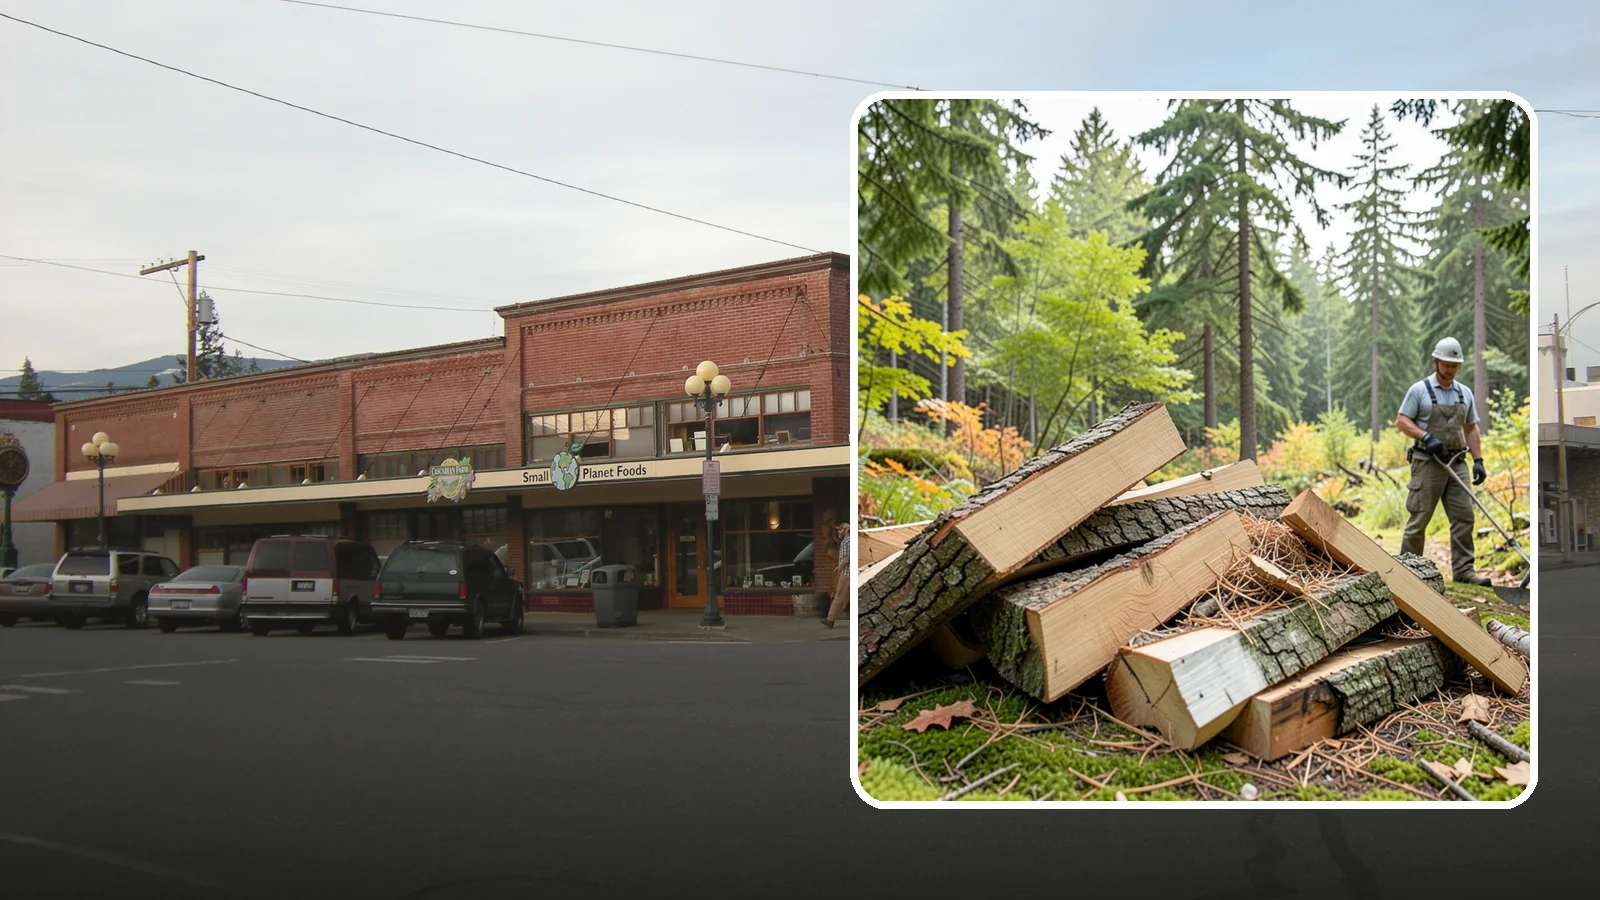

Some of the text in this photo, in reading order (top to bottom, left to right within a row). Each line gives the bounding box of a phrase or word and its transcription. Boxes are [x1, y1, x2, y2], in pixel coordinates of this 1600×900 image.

[523, 464, 647, 482] Small Planet Foods
